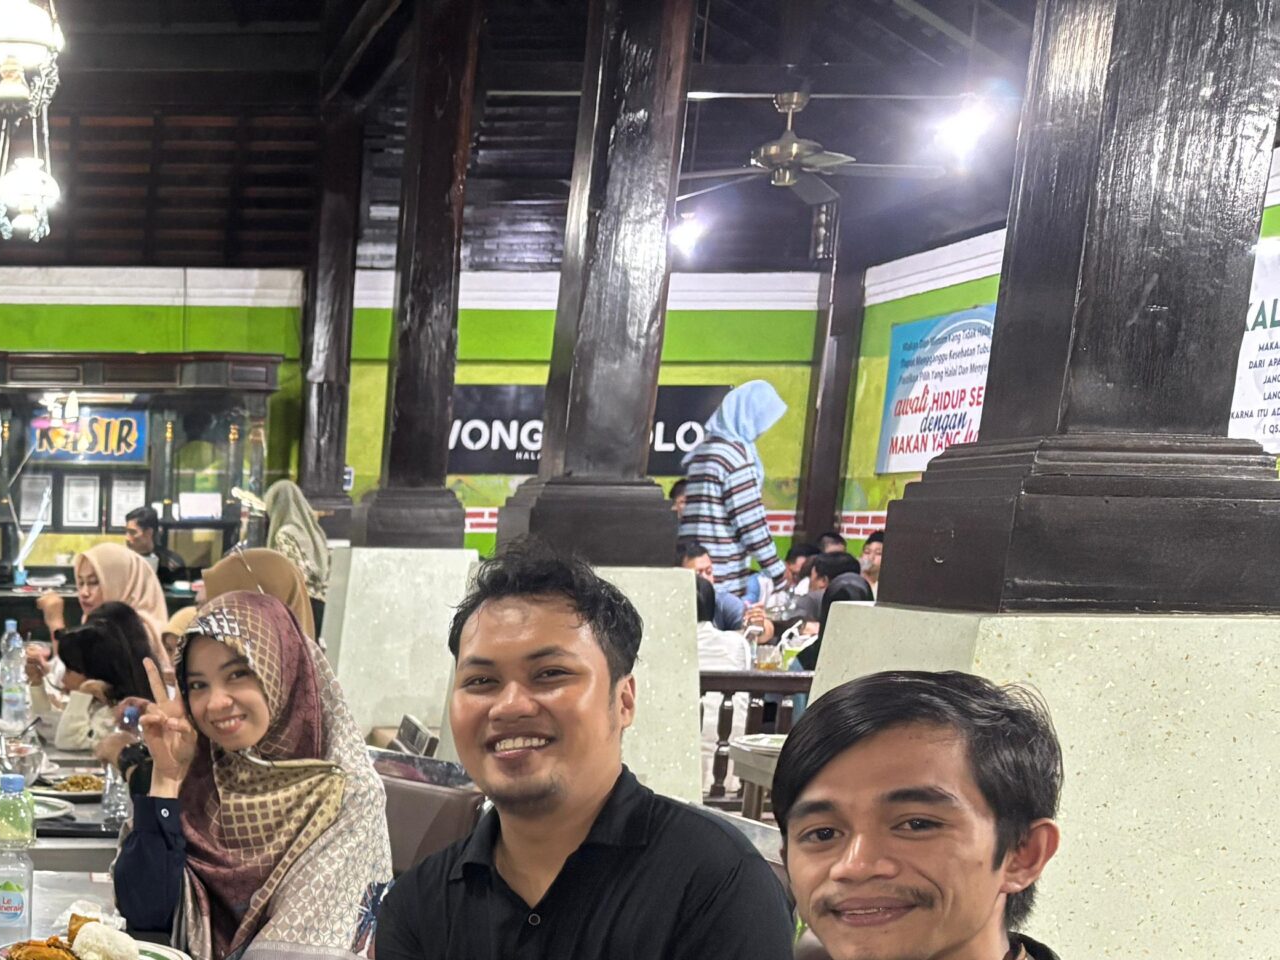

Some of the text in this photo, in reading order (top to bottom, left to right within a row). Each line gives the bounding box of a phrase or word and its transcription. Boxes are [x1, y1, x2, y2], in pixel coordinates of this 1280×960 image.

[949, 347, 975, 360] Kesehatan
[1258, 341, 1280, 352] MAKA
[931, 370, 944, 382] Yang
[958, 364, 969, 376] Dan
[1248, 359, 1265, 370] DARI
[931, 388, 966, 412] HIDUP
[920, 407, 966, 439] dengan
[1231, 409, 1254, 420] KARNA
[1257, 408, 1269, 418] ITU
[649, 421, 705, 453] LO
[889, 433, 928, 454] MAKAN
